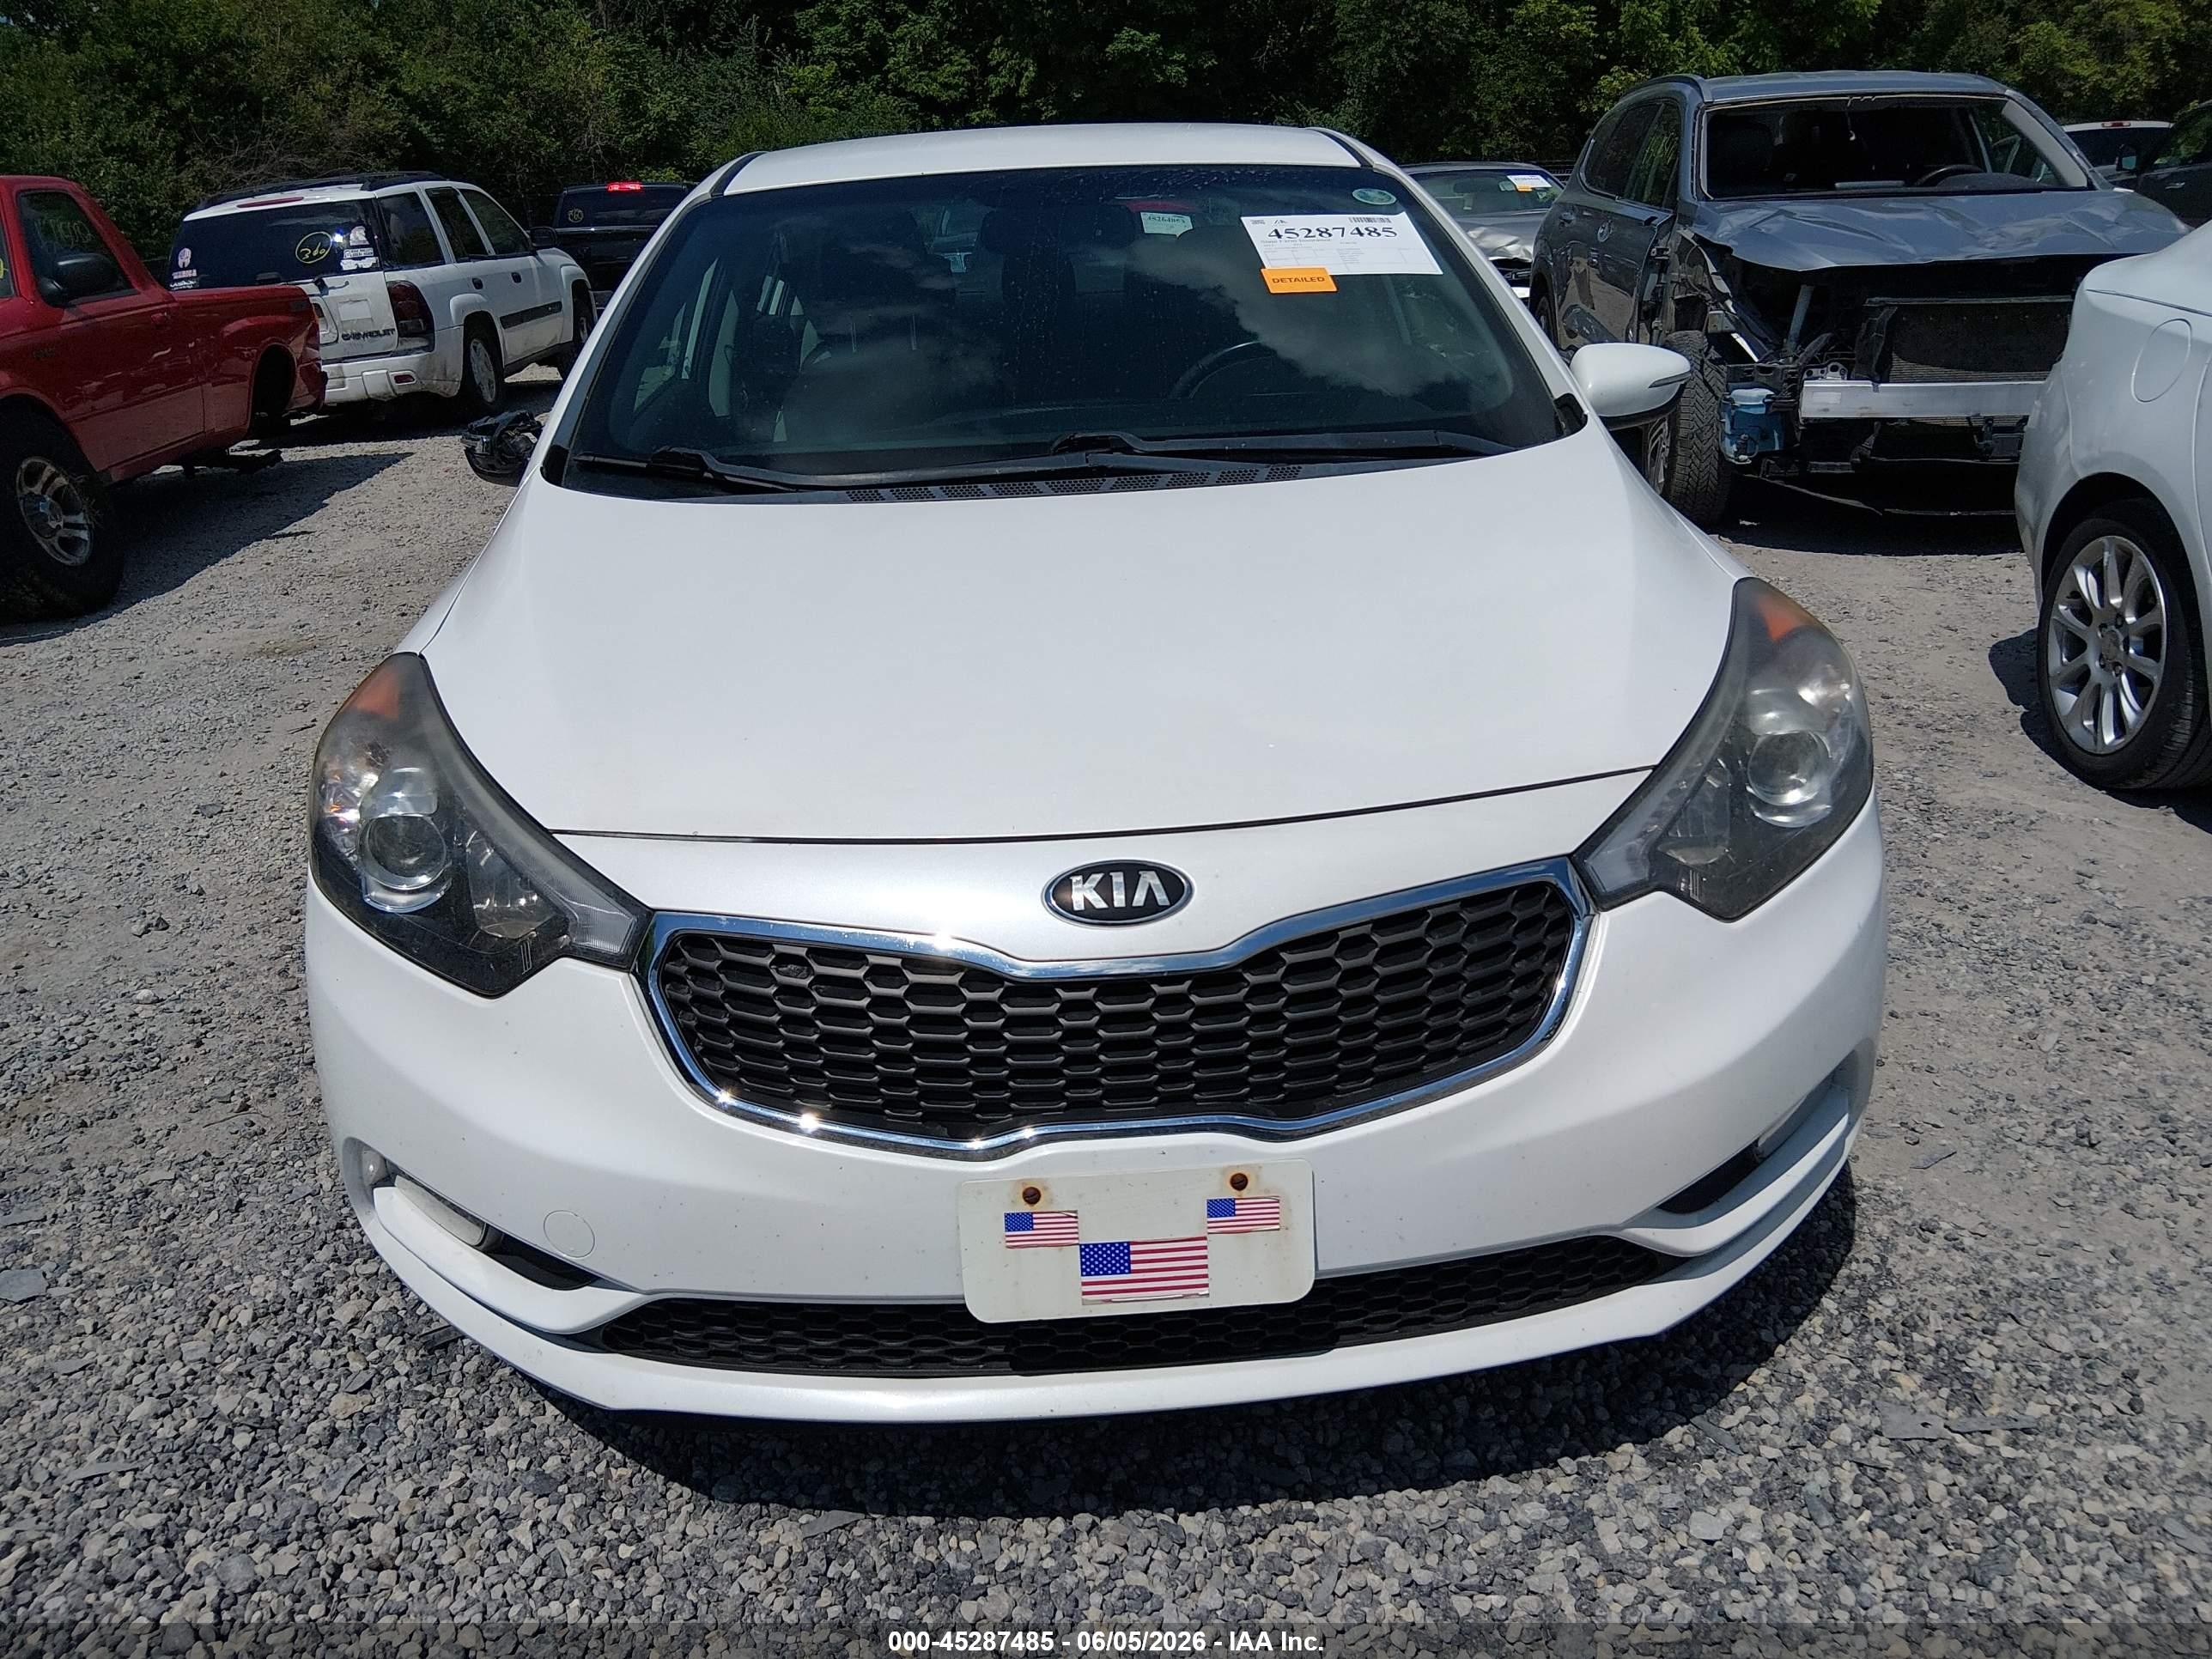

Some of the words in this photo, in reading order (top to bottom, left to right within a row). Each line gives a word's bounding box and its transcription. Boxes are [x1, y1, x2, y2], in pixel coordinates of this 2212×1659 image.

[1267, 227, 1398, 240] 45287485
[1272, 276, 1326, 284] DETAILED
[341, 328, 396, 341] CHEVROLET
[1069, 870, 1170, 911] KIA
